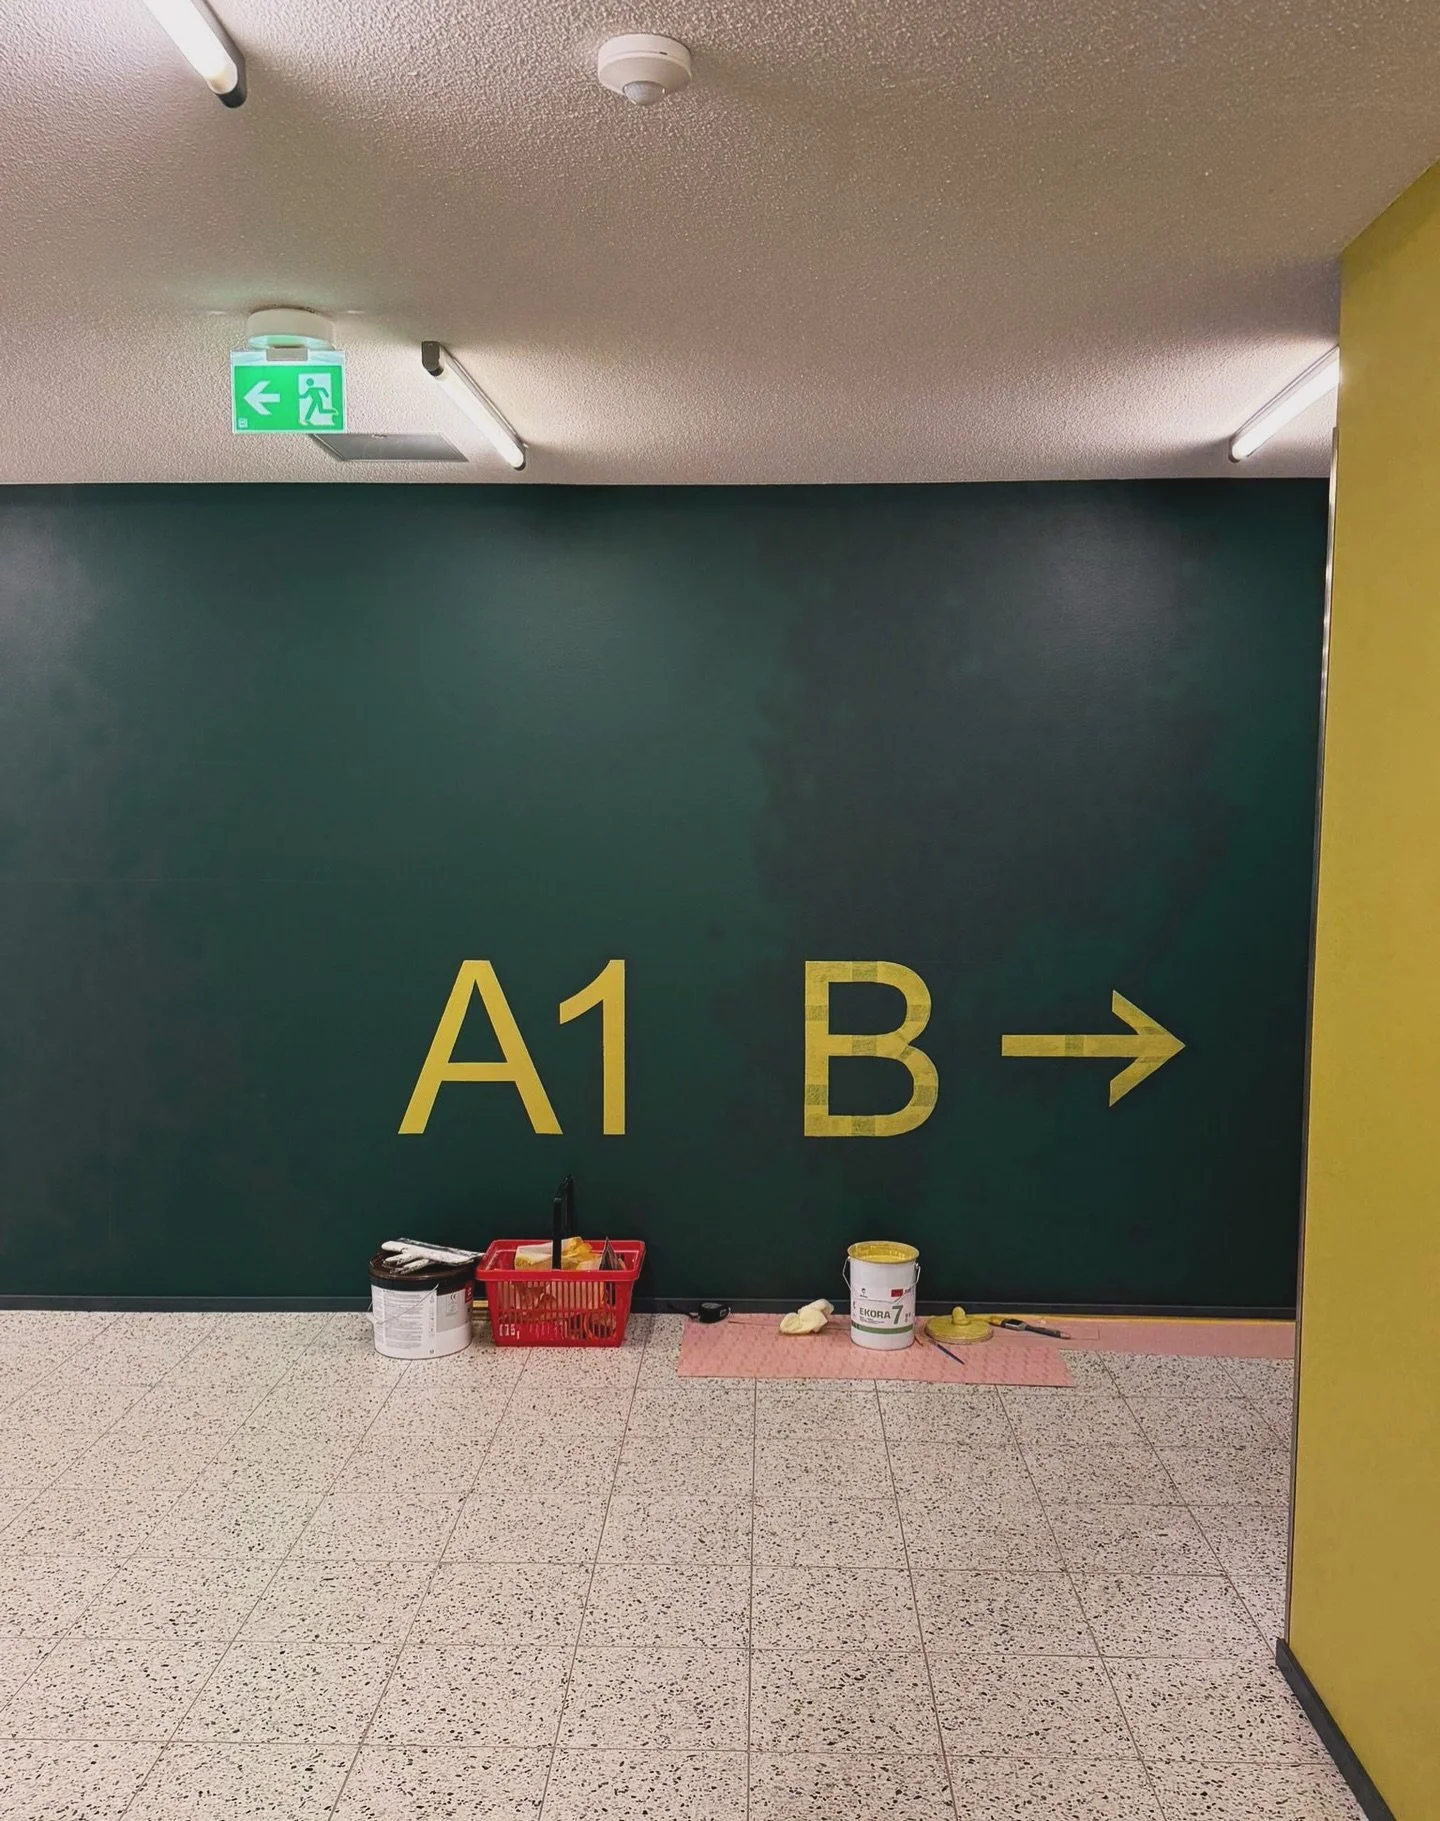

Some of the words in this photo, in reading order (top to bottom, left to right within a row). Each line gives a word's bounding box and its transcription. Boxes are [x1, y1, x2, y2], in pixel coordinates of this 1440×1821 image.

[398, 959, 627, 1136] A1
[803, 960, 939, 1138] B
[859, 1307, 891, 1319] EKORA
[892, 1304, 904, 1325] 7
